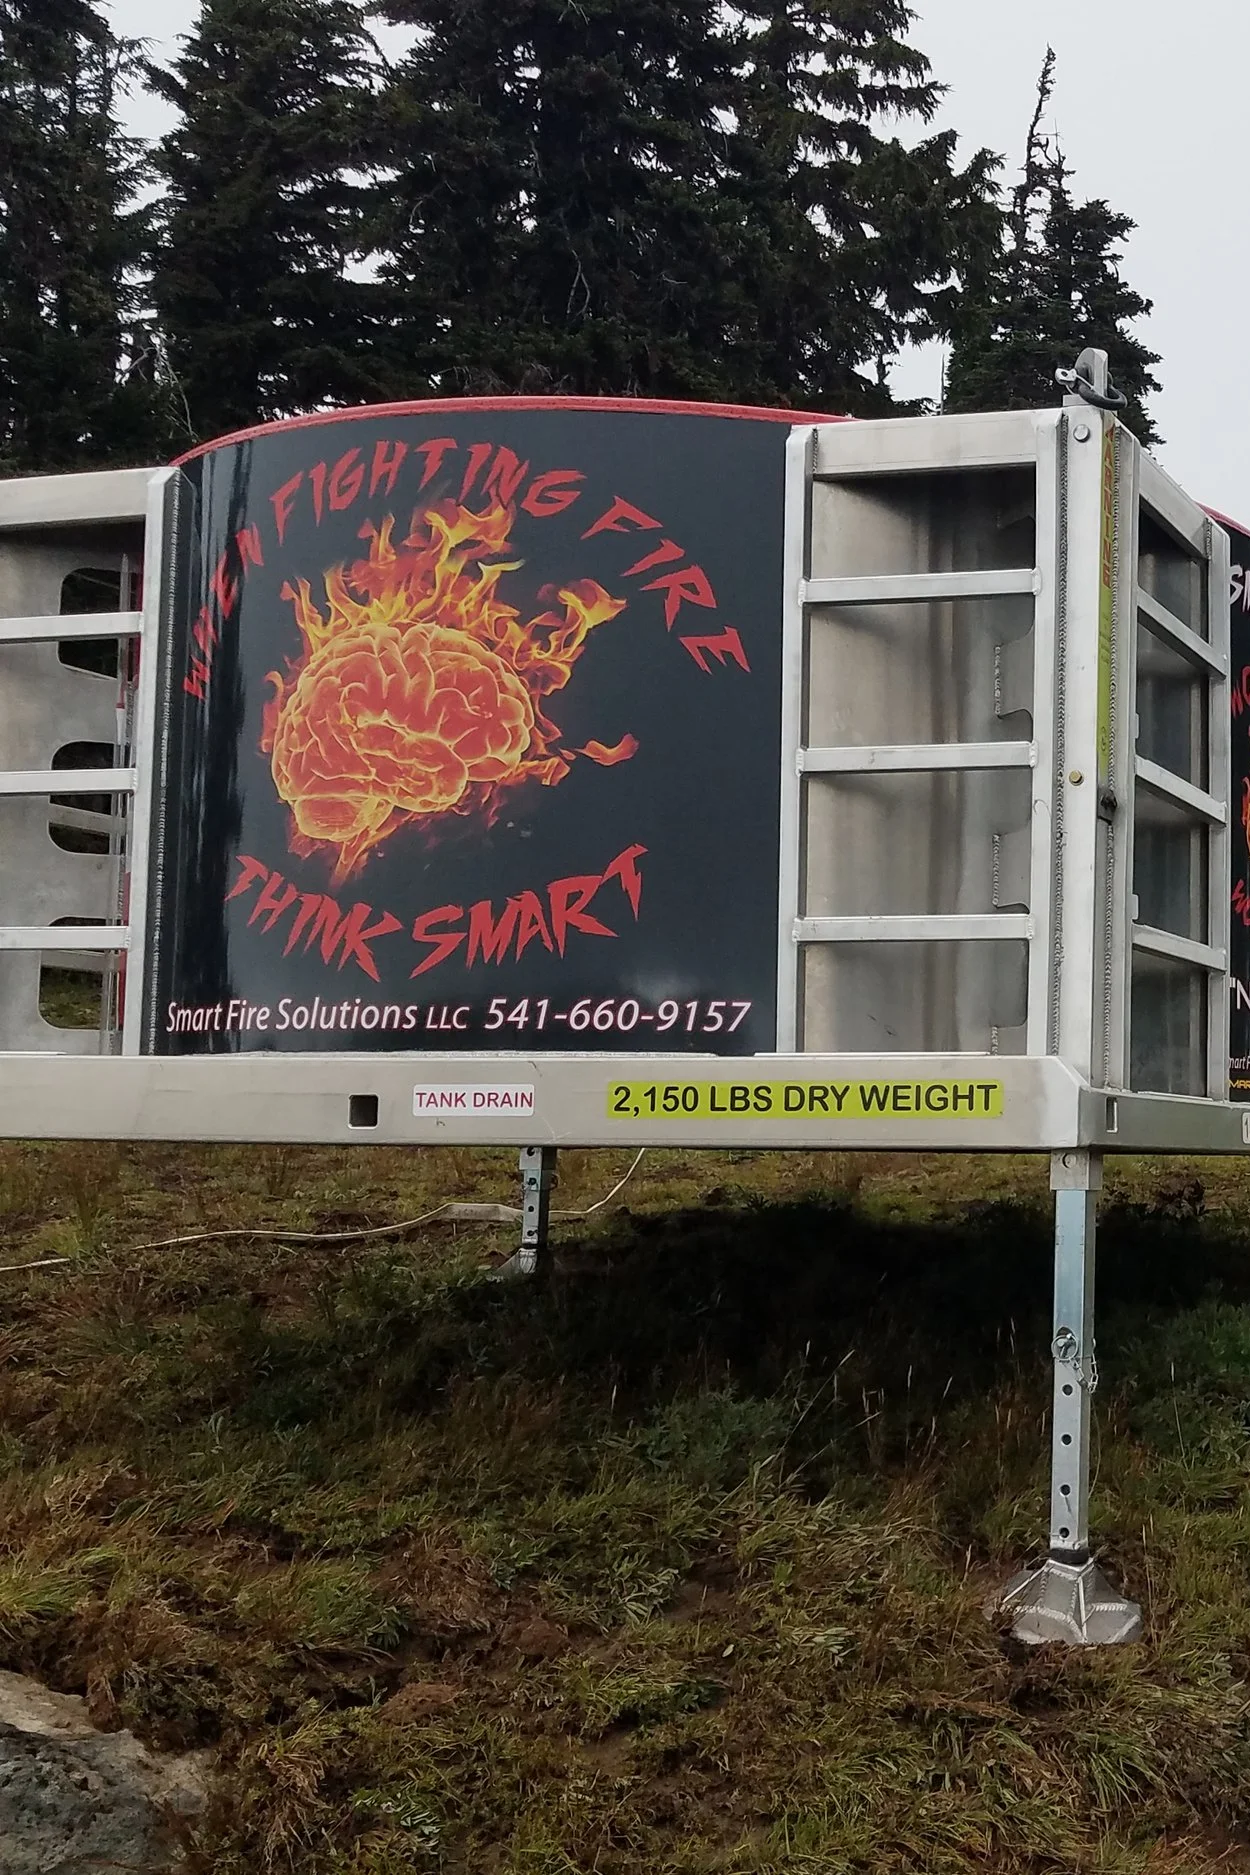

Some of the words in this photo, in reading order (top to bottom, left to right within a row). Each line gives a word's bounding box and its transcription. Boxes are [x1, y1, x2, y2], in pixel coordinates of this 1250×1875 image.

[184, 522, 263, 700] WHEN
[270, 438, 587, 546] FIGHTING
[580, 496, 751, 674] FIRE
[225, 854, 405, 982] THINK
[410, 843, 648, 979] SMART
[166, 1001, 222, 1032] Smart
[226, 999, 269, 1031] Fire
[276, 998, 418, 1030] Solutions
[426, 1006, 470, 1029] LLC
[484, 999, 752, 1033] 541-660-9157
[416, 1091, 467, 1109] TANK
[472, 1091, 533, 1109] DRAIN
[613, 1085, 700, 1117] 2,150
[708, 1085, 772, 1112] LBS
[783, 1085, 850, 1112] DRY
[859, 1084, 998, 1112] WEIGHT
